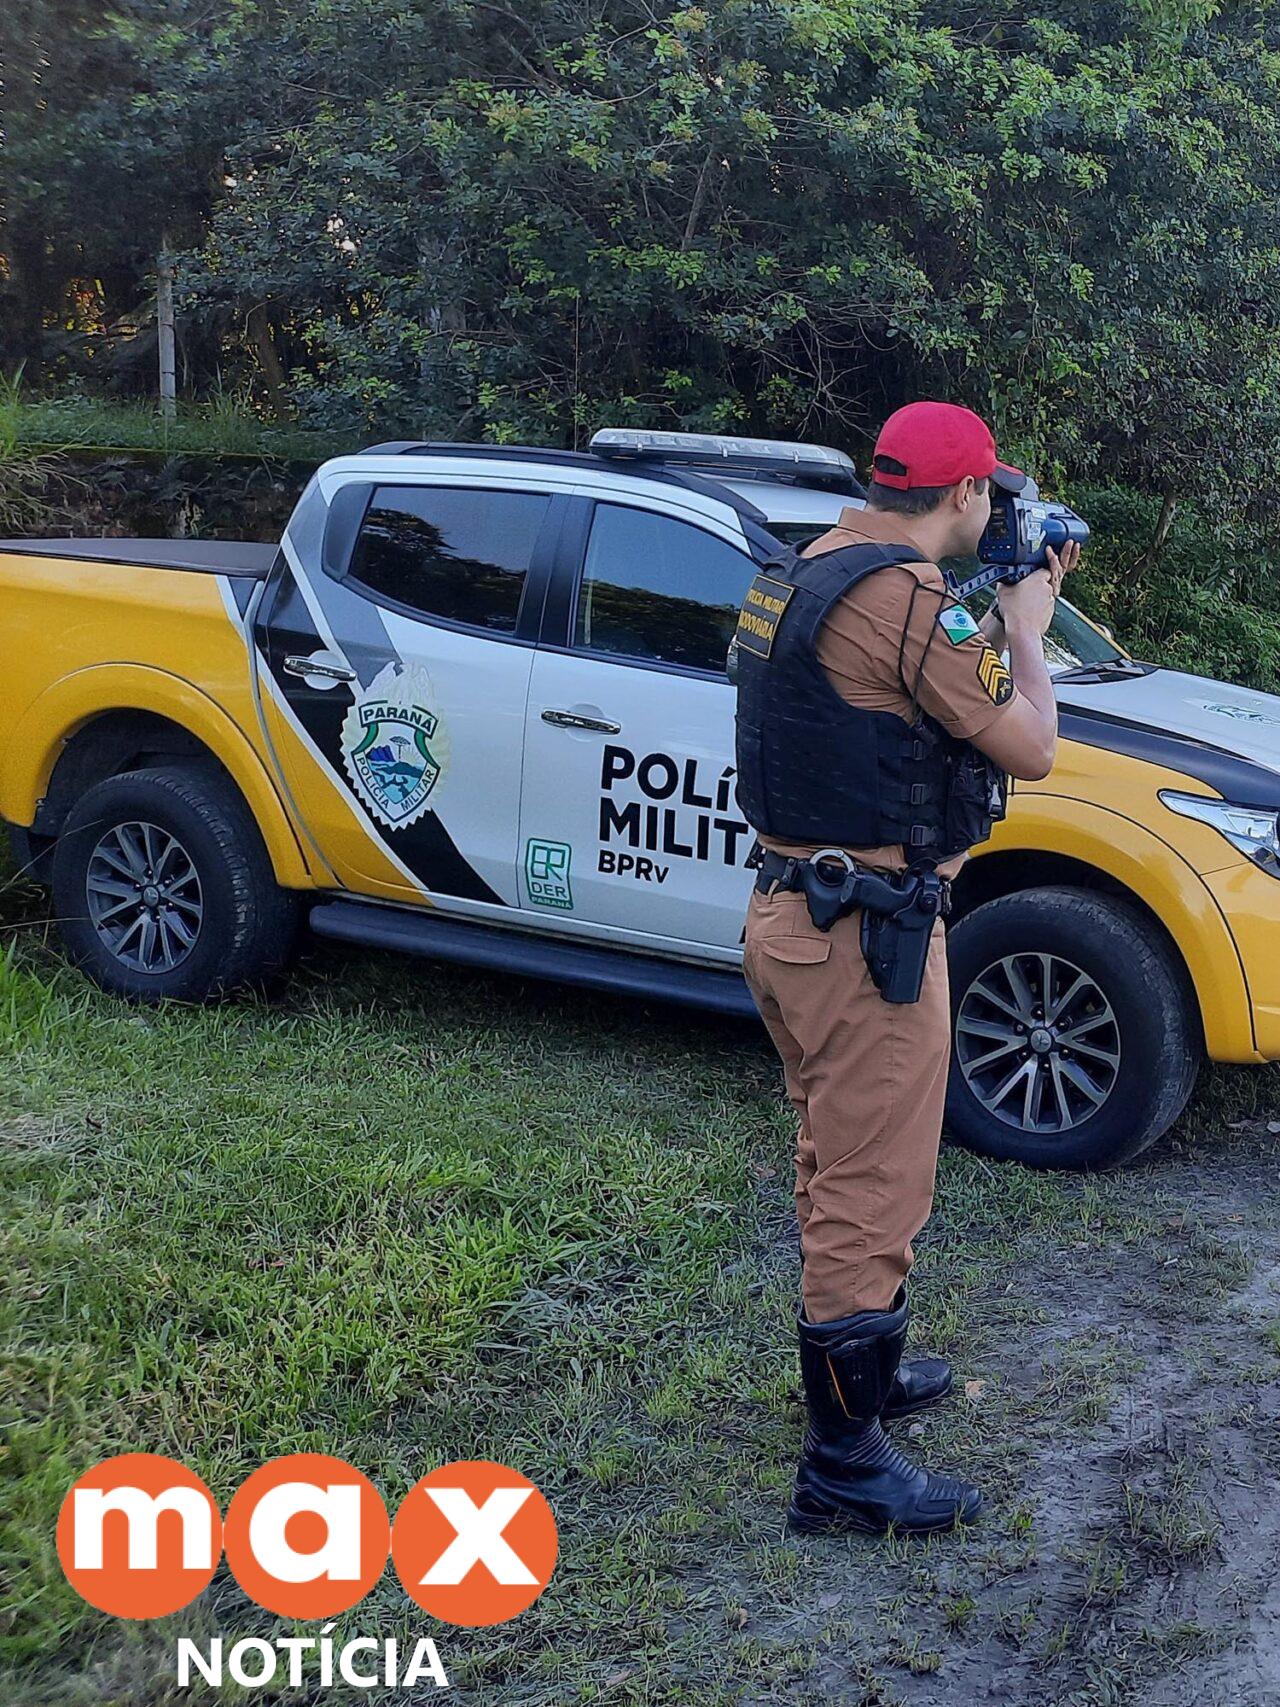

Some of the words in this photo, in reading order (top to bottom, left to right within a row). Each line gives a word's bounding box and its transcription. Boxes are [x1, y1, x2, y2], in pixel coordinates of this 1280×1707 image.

[363, 706, 432, 732] PARANÁ
[400, 768, 435, 812] MILITAR
[601, 744, 738, 812] POLÍ
[599, 797, 757, 869] MILIT
[531, 881, 568, 899] DER
